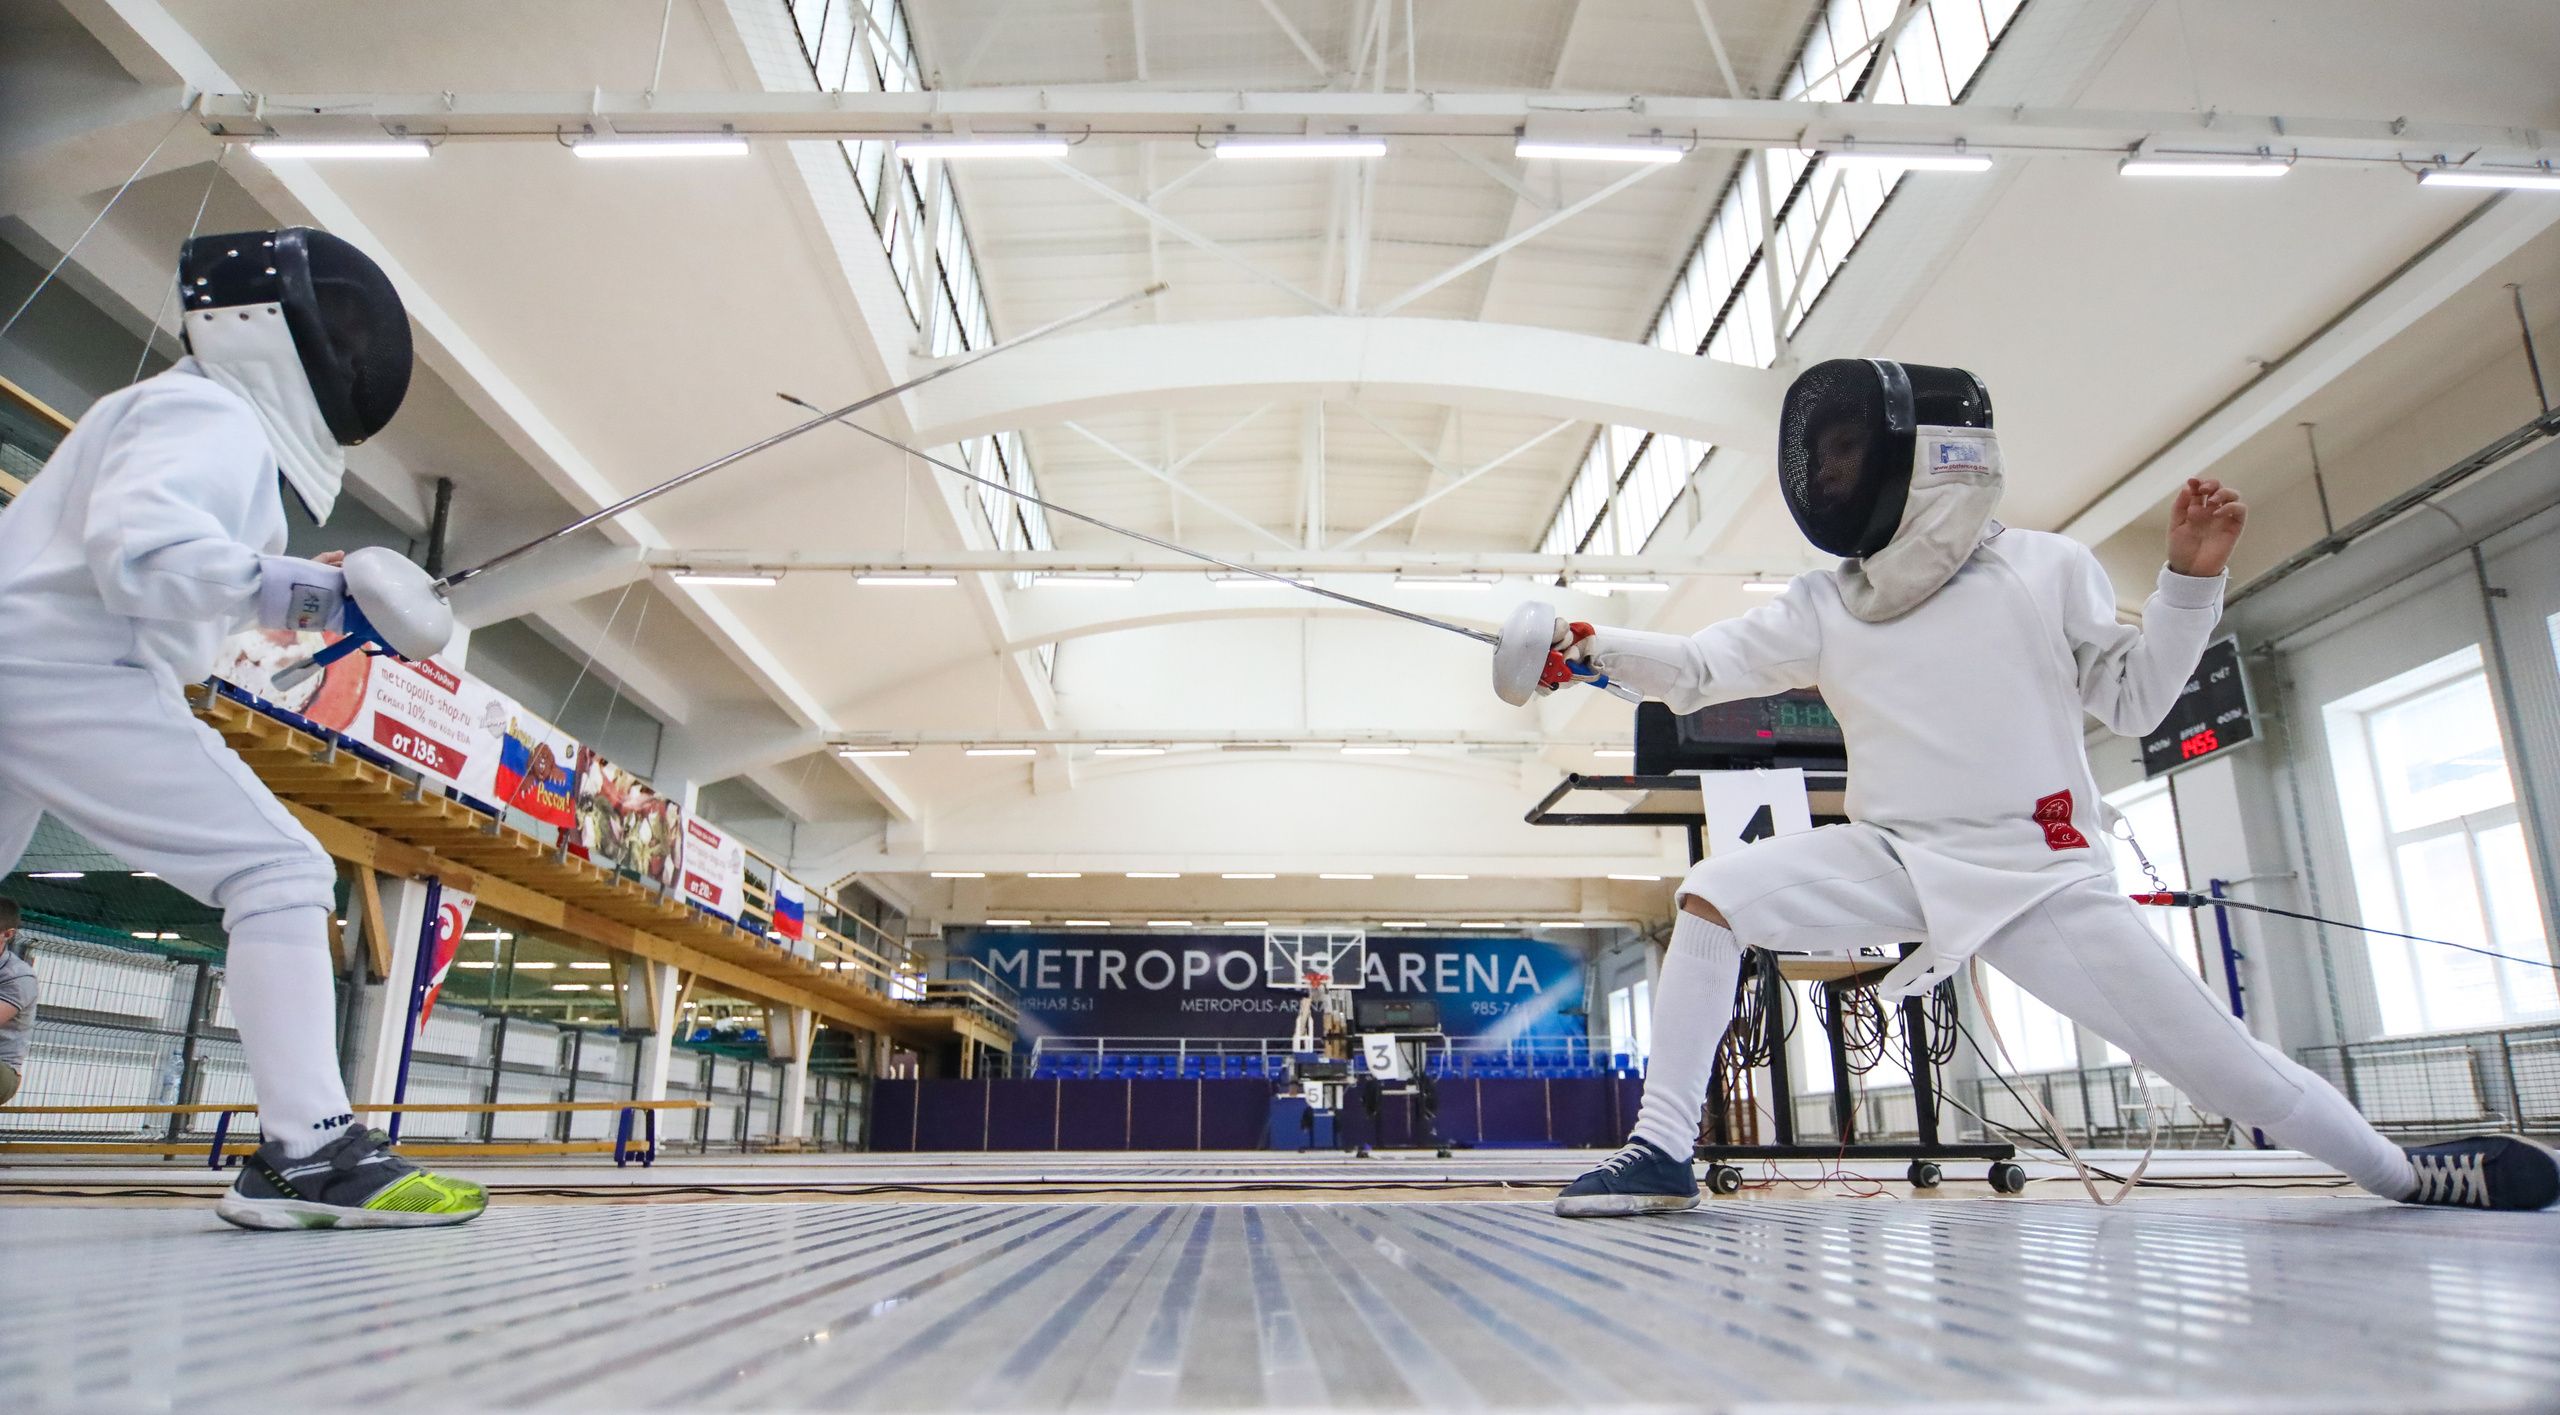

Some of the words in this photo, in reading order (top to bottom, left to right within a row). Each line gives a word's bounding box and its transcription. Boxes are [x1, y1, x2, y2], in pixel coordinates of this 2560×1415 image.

[381, 667, 471, 726] metropolis-shop.ru
[376, 689, 405, 712] Скидка
[407, 701, 427, 724] 10%
[428, 717, 438, 729] по
[440, 723, 456, 740] коду
[391, 733, 411, 753] от
[1366, 951, 1542, 994] ARENA
[1372, 1044, 1392, 1071] 3
[1308, 1088, 1319, 1103] 5
